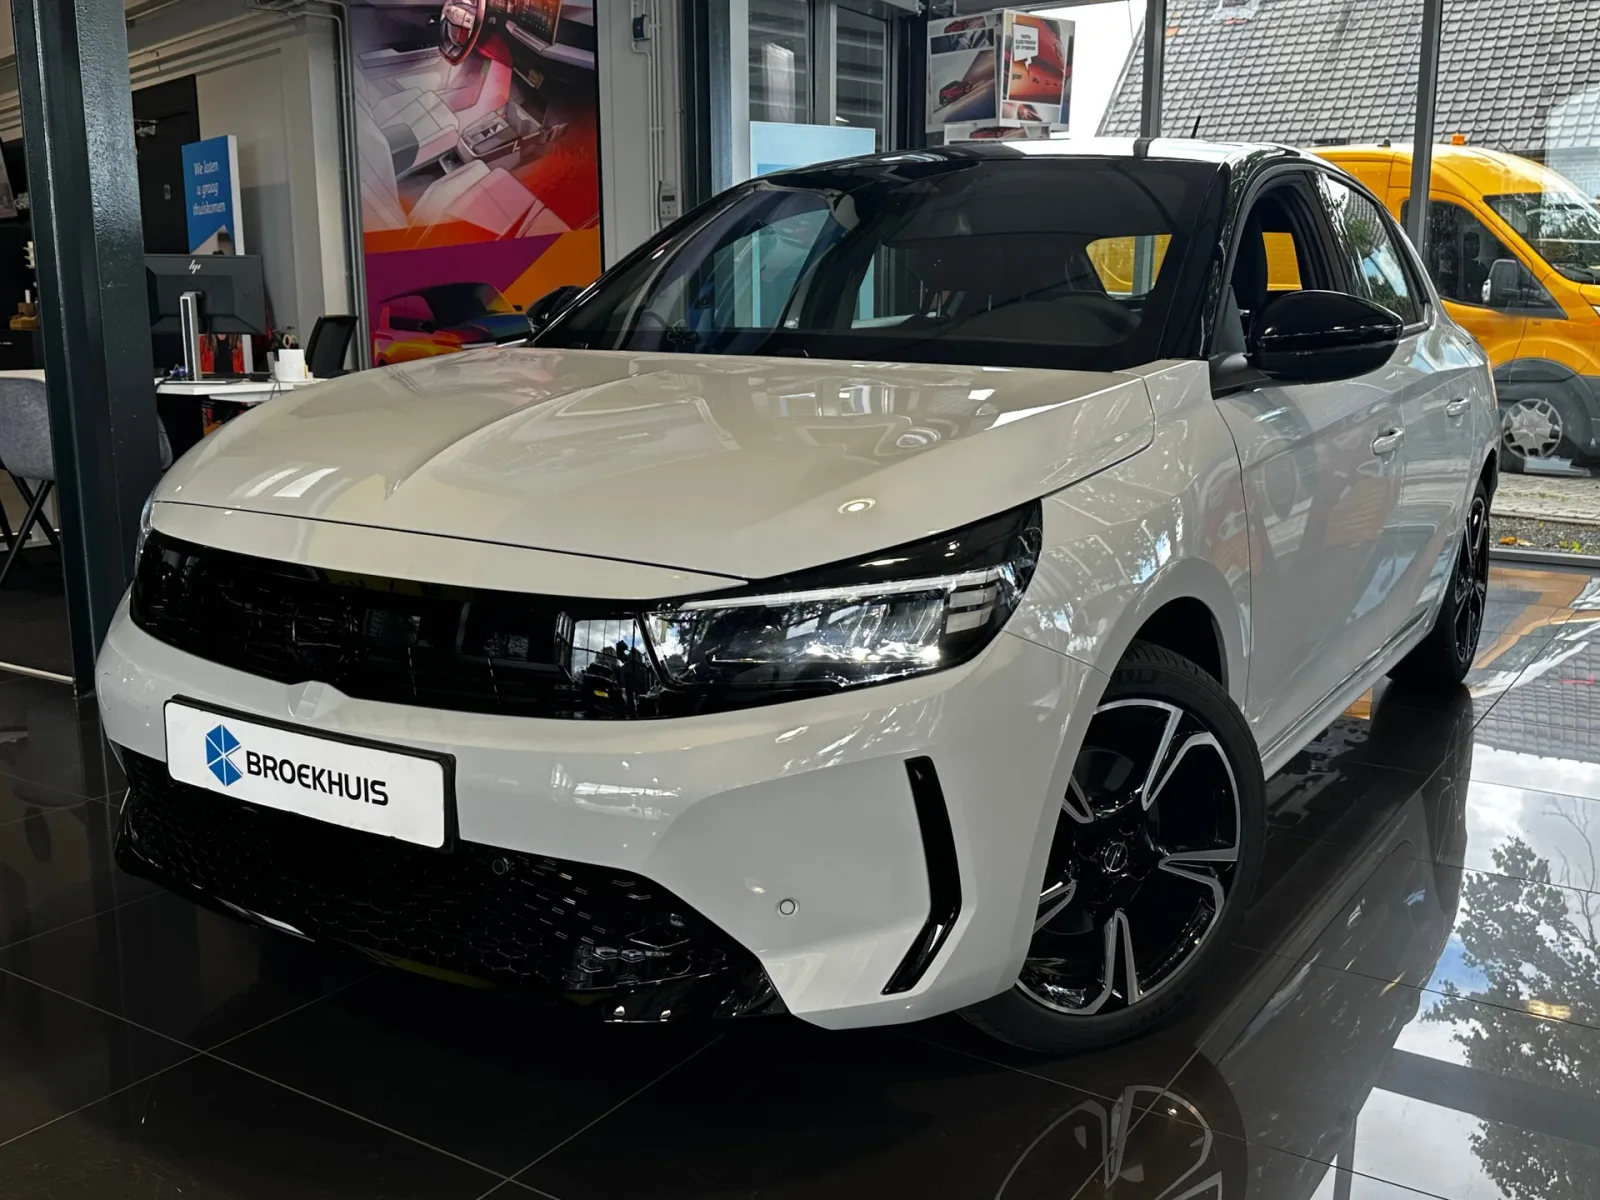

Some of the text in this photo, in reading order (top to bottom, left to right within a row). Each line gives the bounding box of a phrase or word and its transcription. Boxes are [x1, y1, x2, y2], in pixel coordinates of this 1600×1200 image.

[193, 160, 218, 175] We laten
[196, 182, 218, 199] u graag
[193, 201, 225, 216] thuiskomen
[246, 750, 389, 806] BROEKHUIS
